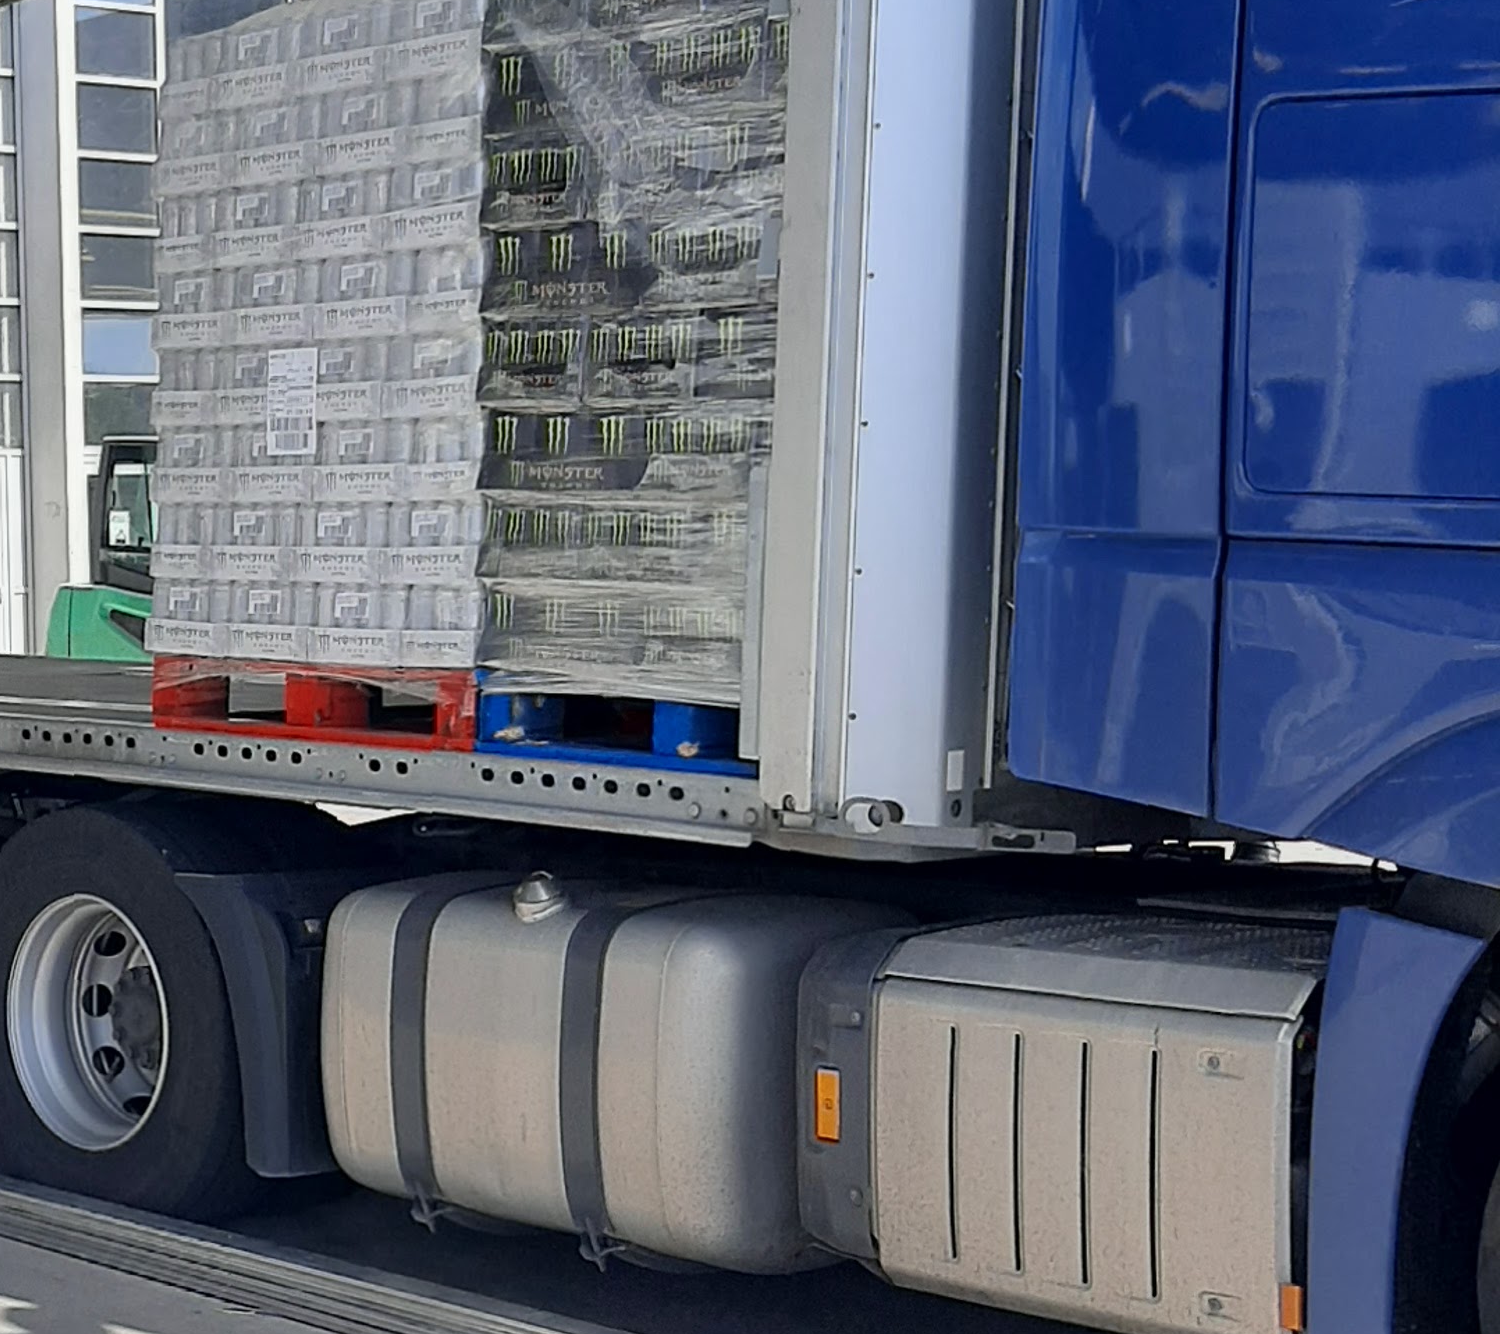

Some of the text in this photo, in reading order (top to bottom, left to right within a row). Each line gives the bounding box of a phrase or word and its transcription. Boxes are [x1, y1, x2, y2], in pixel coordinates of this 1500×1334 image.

[411, 39, 468, 57] MONSTER
[339, 136, 391, 152] MONSTER
[409, 210, 466, 227] MONSTER
[532, 280, 611, 298] MONSTER
[339, 304, 393, 318] MONSTER
[339, 471, 392, 483] MONSTER
[529, 464, 604, 481] MONSTER
[406, 553, 463, 565] MONSTER
